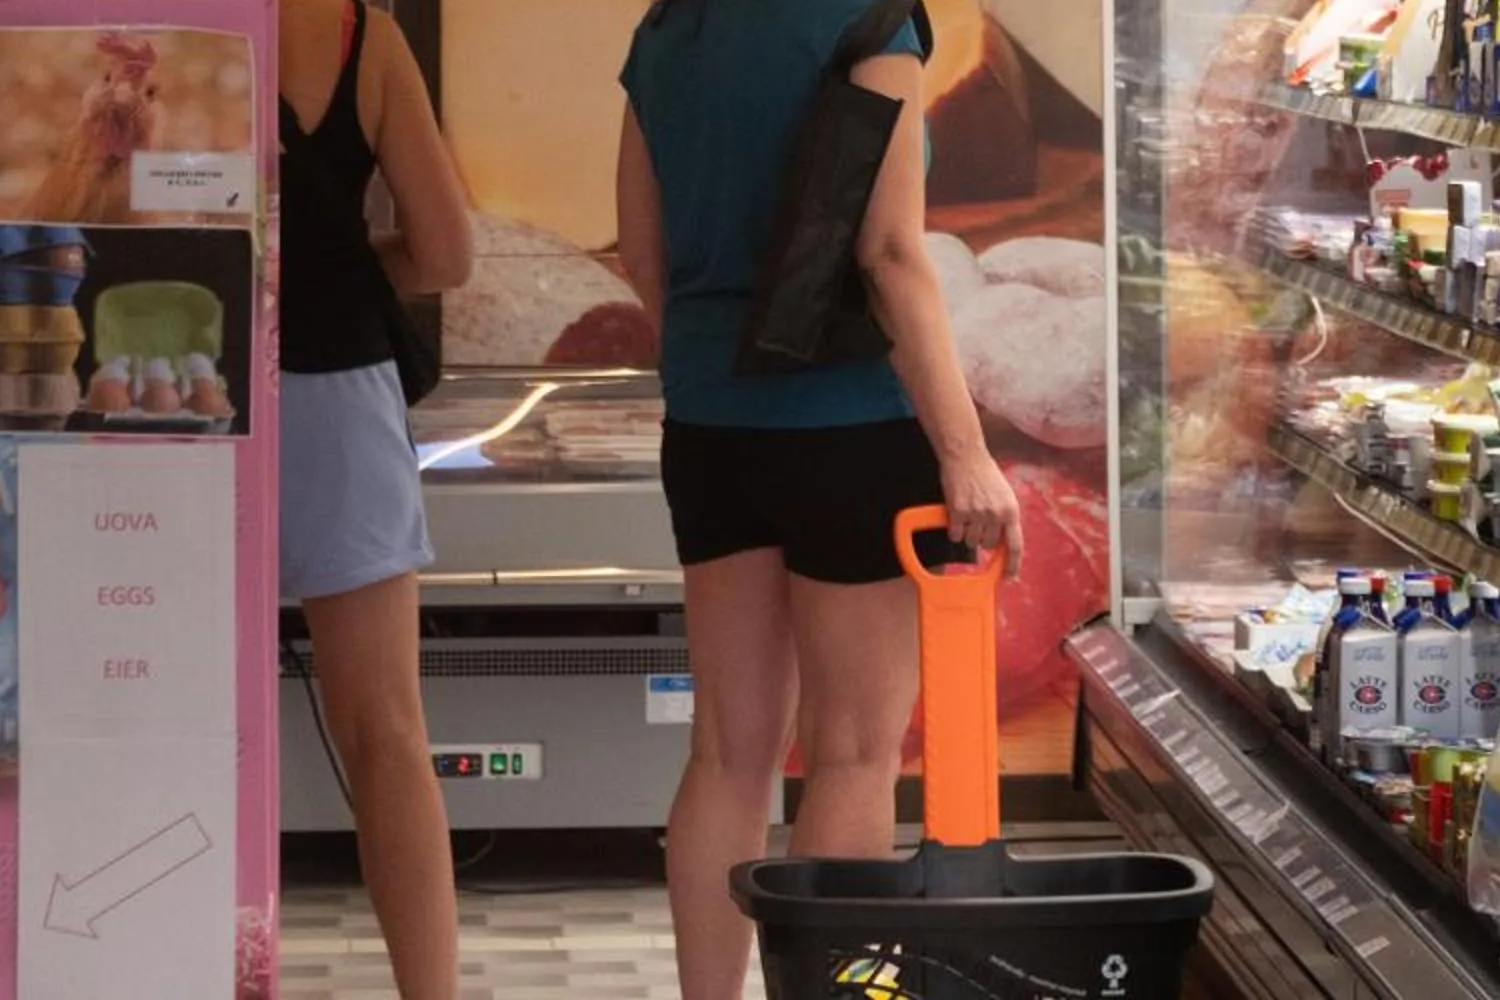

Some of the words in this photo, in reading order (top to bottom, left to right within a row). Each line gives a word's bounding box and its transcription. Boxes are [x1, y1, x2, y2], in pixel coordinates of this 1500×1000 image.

[94, 512, 159, 532] UOVA
[98, 586, 155, 606] EGGS
[103, 659, 150, 681] EIER
